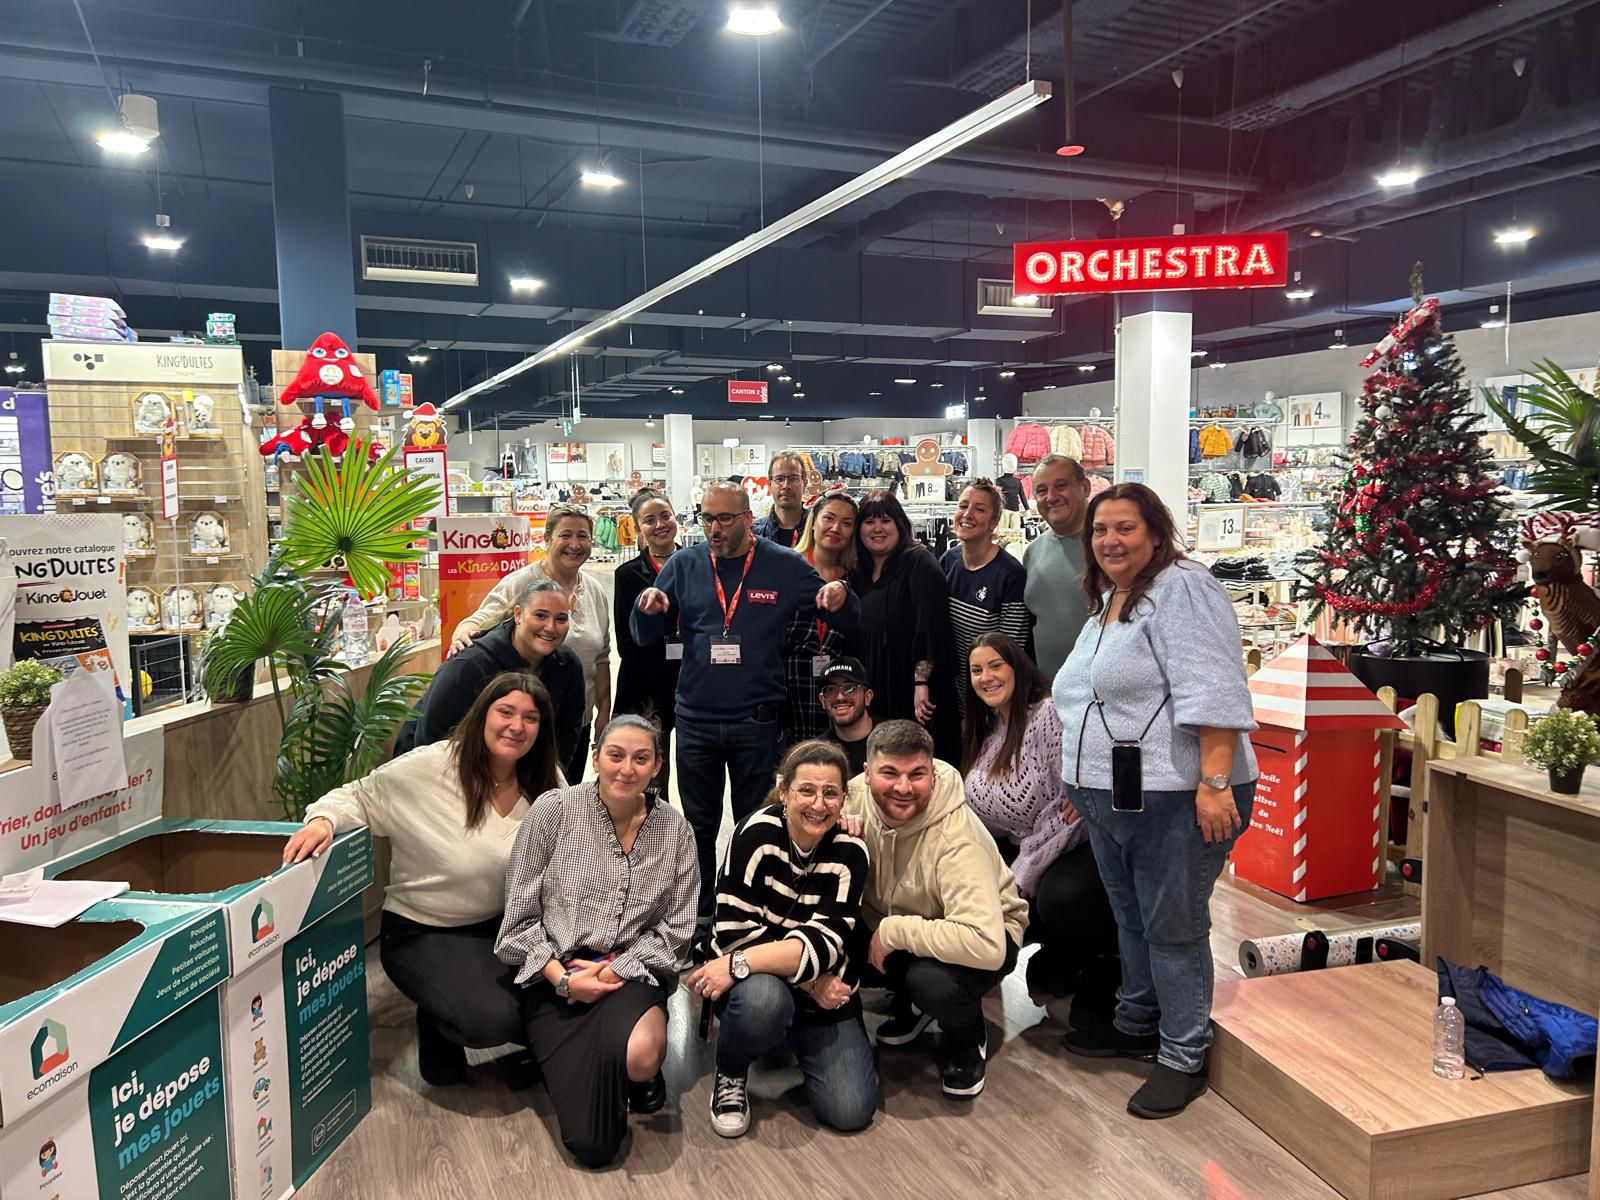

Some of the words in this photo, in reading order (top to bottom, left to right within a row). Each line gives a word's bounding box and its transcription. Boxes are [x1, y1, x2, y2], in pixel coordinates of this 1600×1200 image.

[1025, 243, 1275, 284] ORCHESTRA
[156, 354, 213, 369] KING'DULTES
[1314, 401, 1322, 419] 4
[749, 448, 755, 460] 8
[927, 482, 933, 493] 8
[1222, 518, 1234, 534] 13
[9, 548, 43, 557] ouvrez
[46, 546, 71, 555] notre
[74, 544, 116, 554] catalogue
[15, 557, 116, 579] NG'DULTES
[500, 559, 525, 572] DAYS
[72, 589, 107, 602] Jouet
[1253, 795, 1277, 807] ettres
[1258, 808, 1269, 819] du
[0, 815, 31, 835] rier,
[21, 833, 41, 850] Un
[43, 824, 66, 846] jeu
[69, 800, 126, 832] d'enfant
[1250, 818, 1264, 830] ère
[1265, 823, 1284, 837] Noël
[189, 932, 216, 952] Peluches
[190, 920, 216, 939] Poupées
[172, 957, 194, 975] Petites
[194, 943, 219, 962] voitures
[248, 933, 280, 959] ecomaison
[295, 947, 316, 977] Ici,
[156, 984, 172, 999] Jeux
[172, 978, 181, 989] de
[182, 954, 220, 983] construction
[174, 986, 190, 1000] Jeux
[189, 981, 198, 990] de
[199, 965, 220, 985] société
[296, 980, 311, 1007] je
[312, 944, 357, 989] dépose
[299, 993, 327, 1025] mes
[327, 961, 364, 1007] jouets
[27, 1061, 78, 1100] ecomaison
[111, 1070, 145, 1109] Ici,
[114, 1112, 136, 1148] je
[139, 1056, 210, 1121] dépose
[118, 1124, 161, 1170] mes
[163, 1076, 220, 1140] jouets
[120, 1166, 148, 1194] Déposer
[149, 1155, 163, 1170] mon
[163, 1141, 180, 1160] jouet
[138, 1182, 145, 1191] la
[146, 1158, 172, 1186] garantie
[160, 1166, 177, 1184] d'une
[178, 1144, 202, 1168] nouvelle
[173, 1158, 198, 1184] bonheur
[179, 1179, 187, 1190] ou
